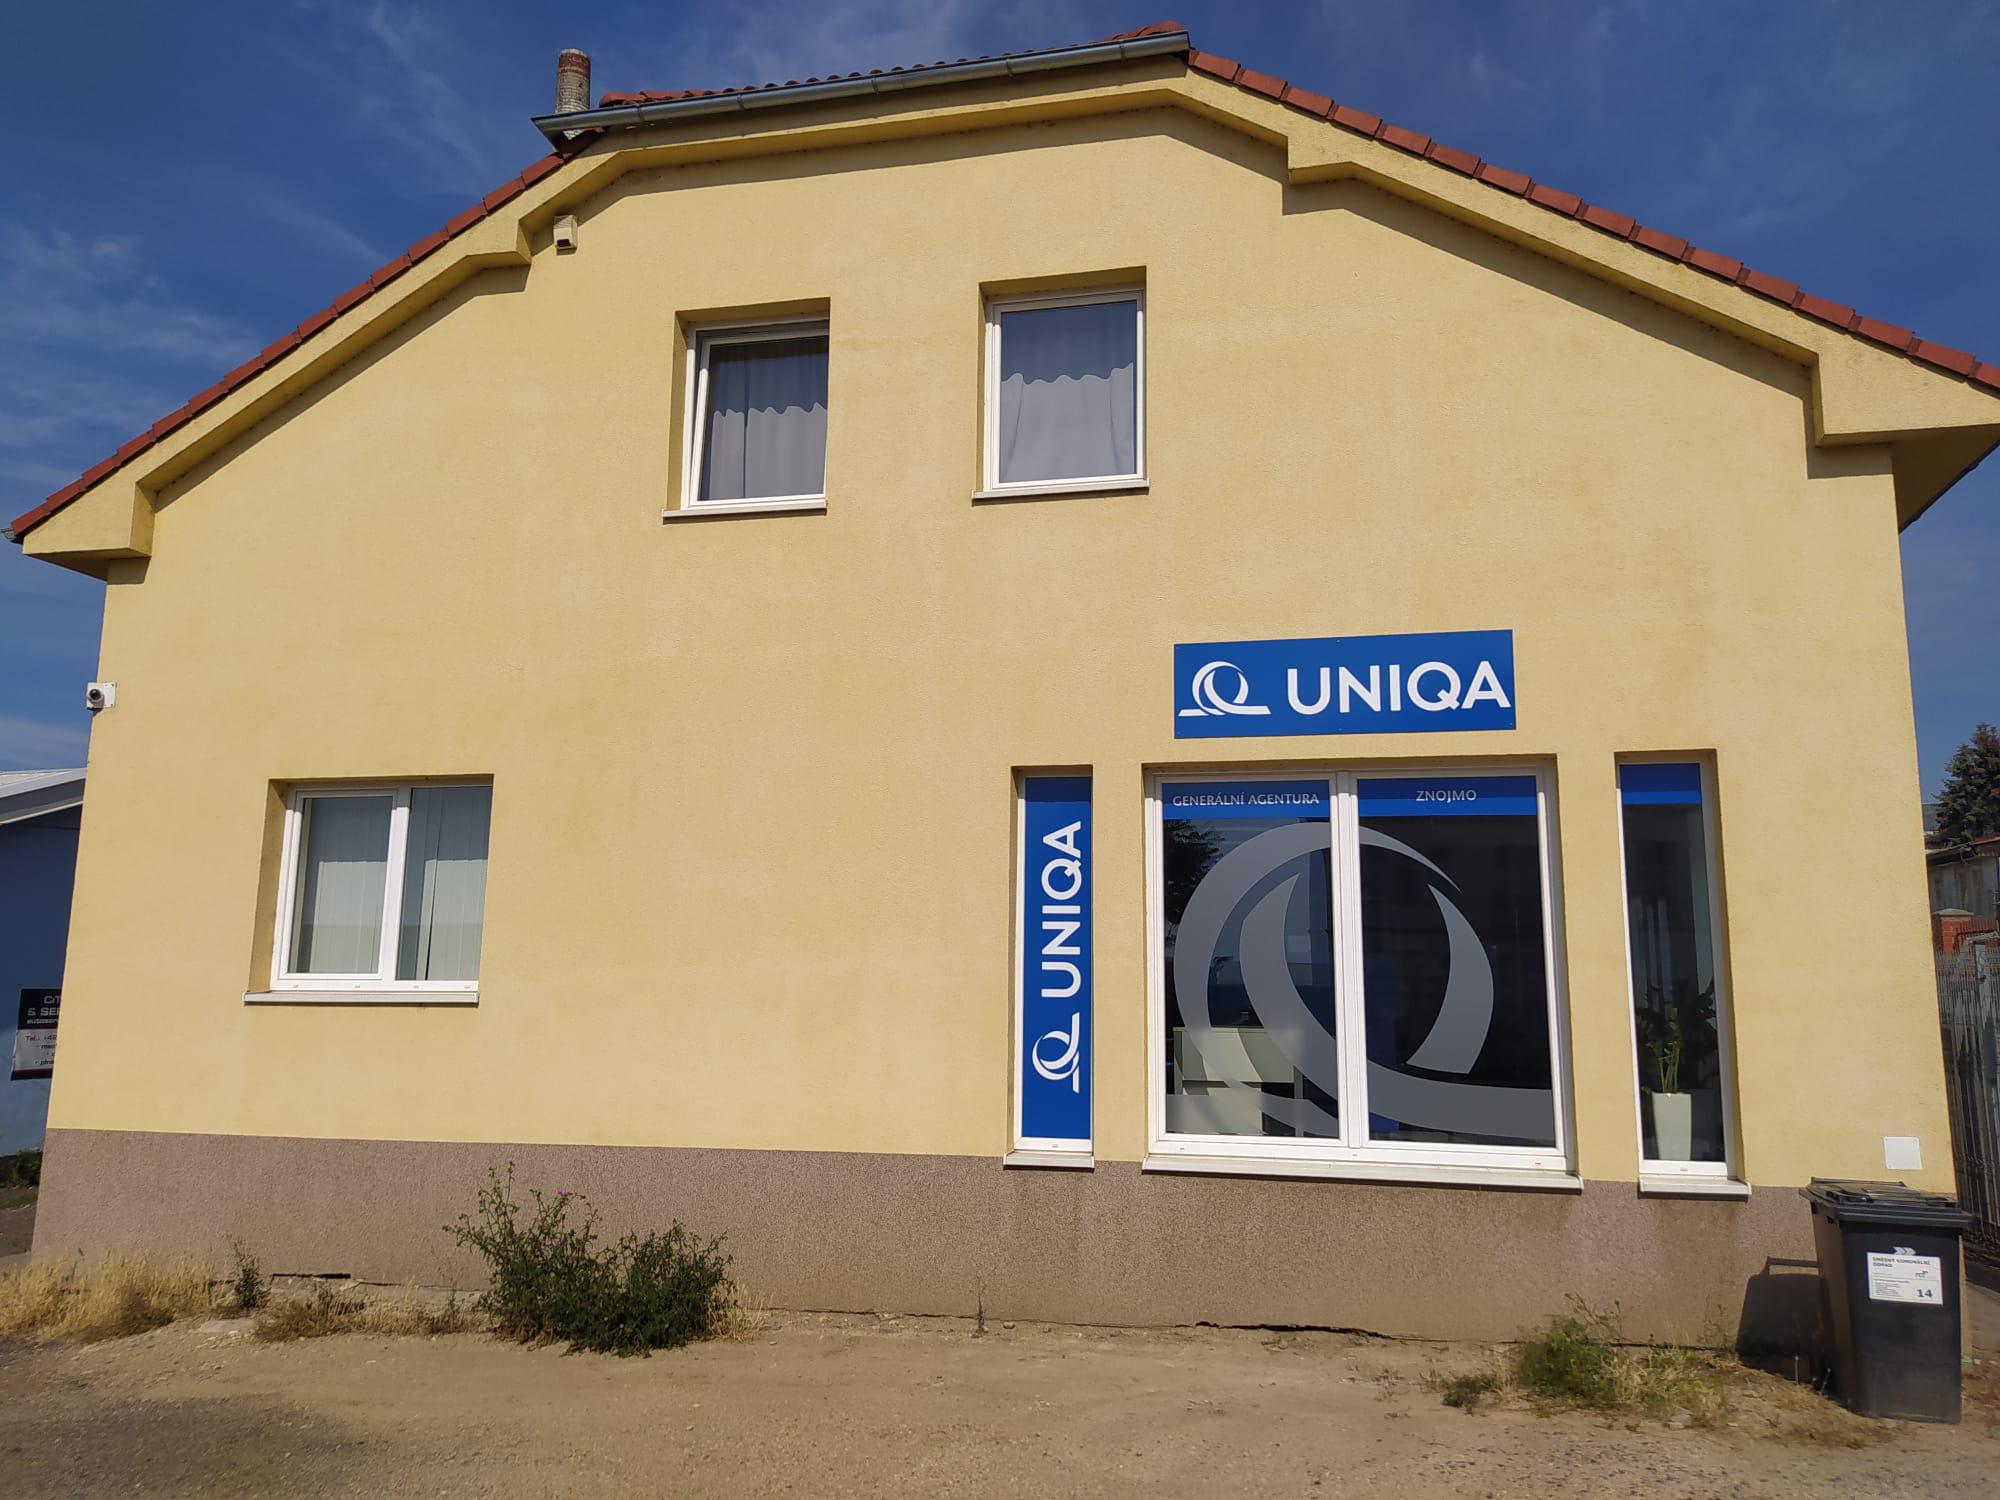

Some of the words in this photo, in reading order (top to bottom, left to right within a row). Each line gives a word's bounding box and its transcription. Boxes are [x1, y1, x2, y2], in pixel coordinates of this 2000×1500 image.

[1287, 660, 1512, 715] UNIQA
[1172, 791, 1245, 806] GENERÁLNÍ
[1247, 793, 1320, 805] AGENTURA
[1415, 789, 1477, 803] ZNOJMO
[1041, 821, 1082, 998] UNIQA
[1917, 1289, 1933, 1298] 14
